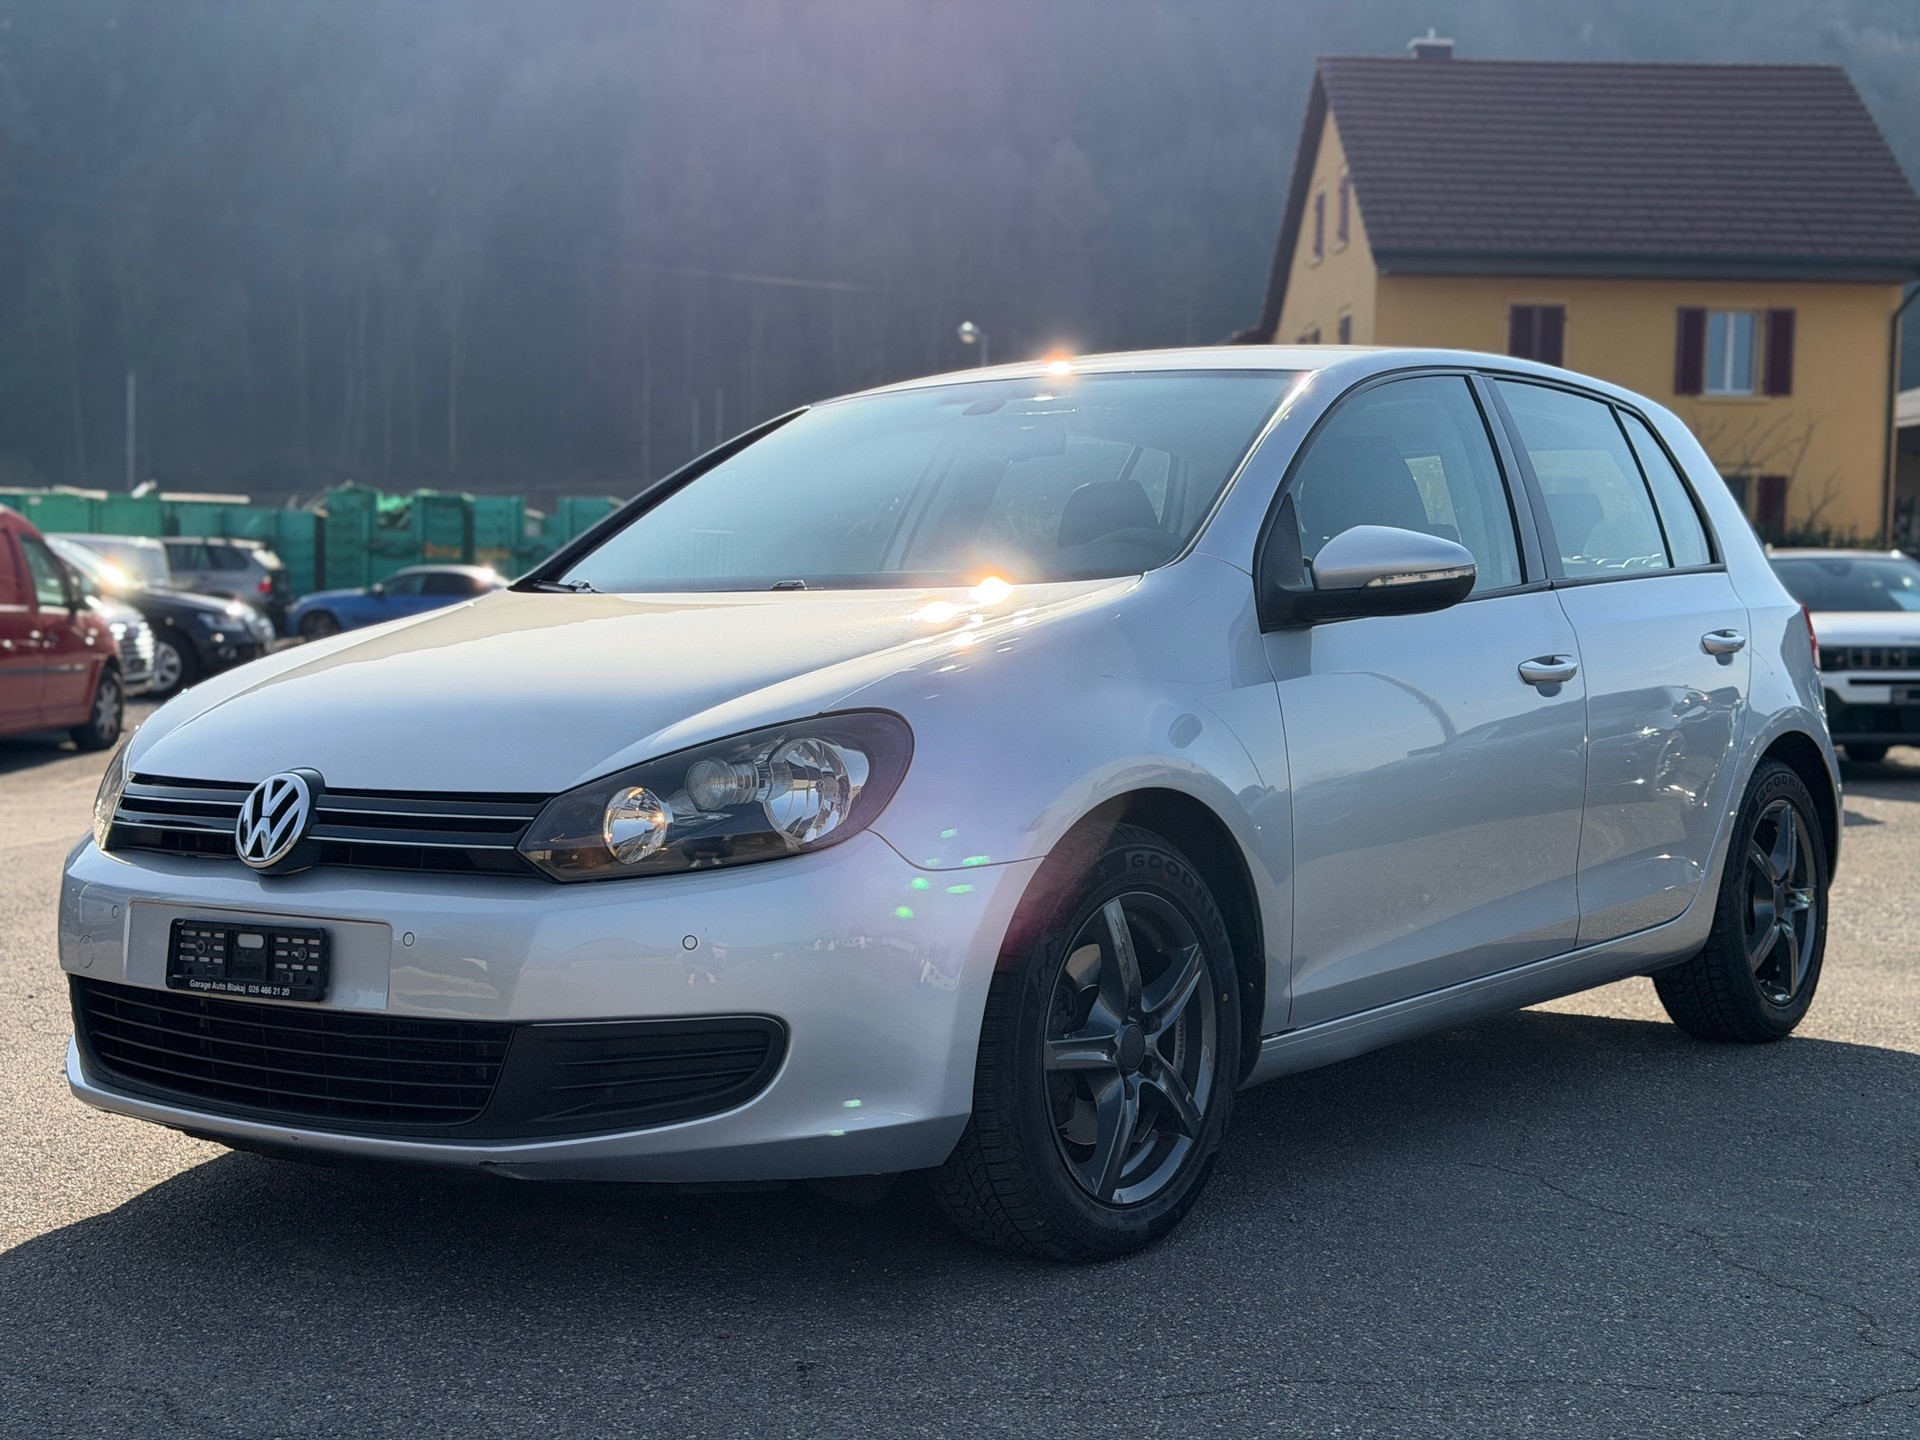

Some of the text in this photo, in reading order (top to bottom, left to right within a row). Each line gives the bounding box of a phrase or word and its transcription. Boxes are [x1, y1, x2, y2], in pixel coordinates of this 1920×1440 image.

[238, 774, 306, 864] VW
[189, 979, 211, 991] Garage
[211, 981, 227, 991] Auto
[248, 984, 260, 994] 026
[272, 986, 280, 995] 21
[281, 987, 290, 996] 20
